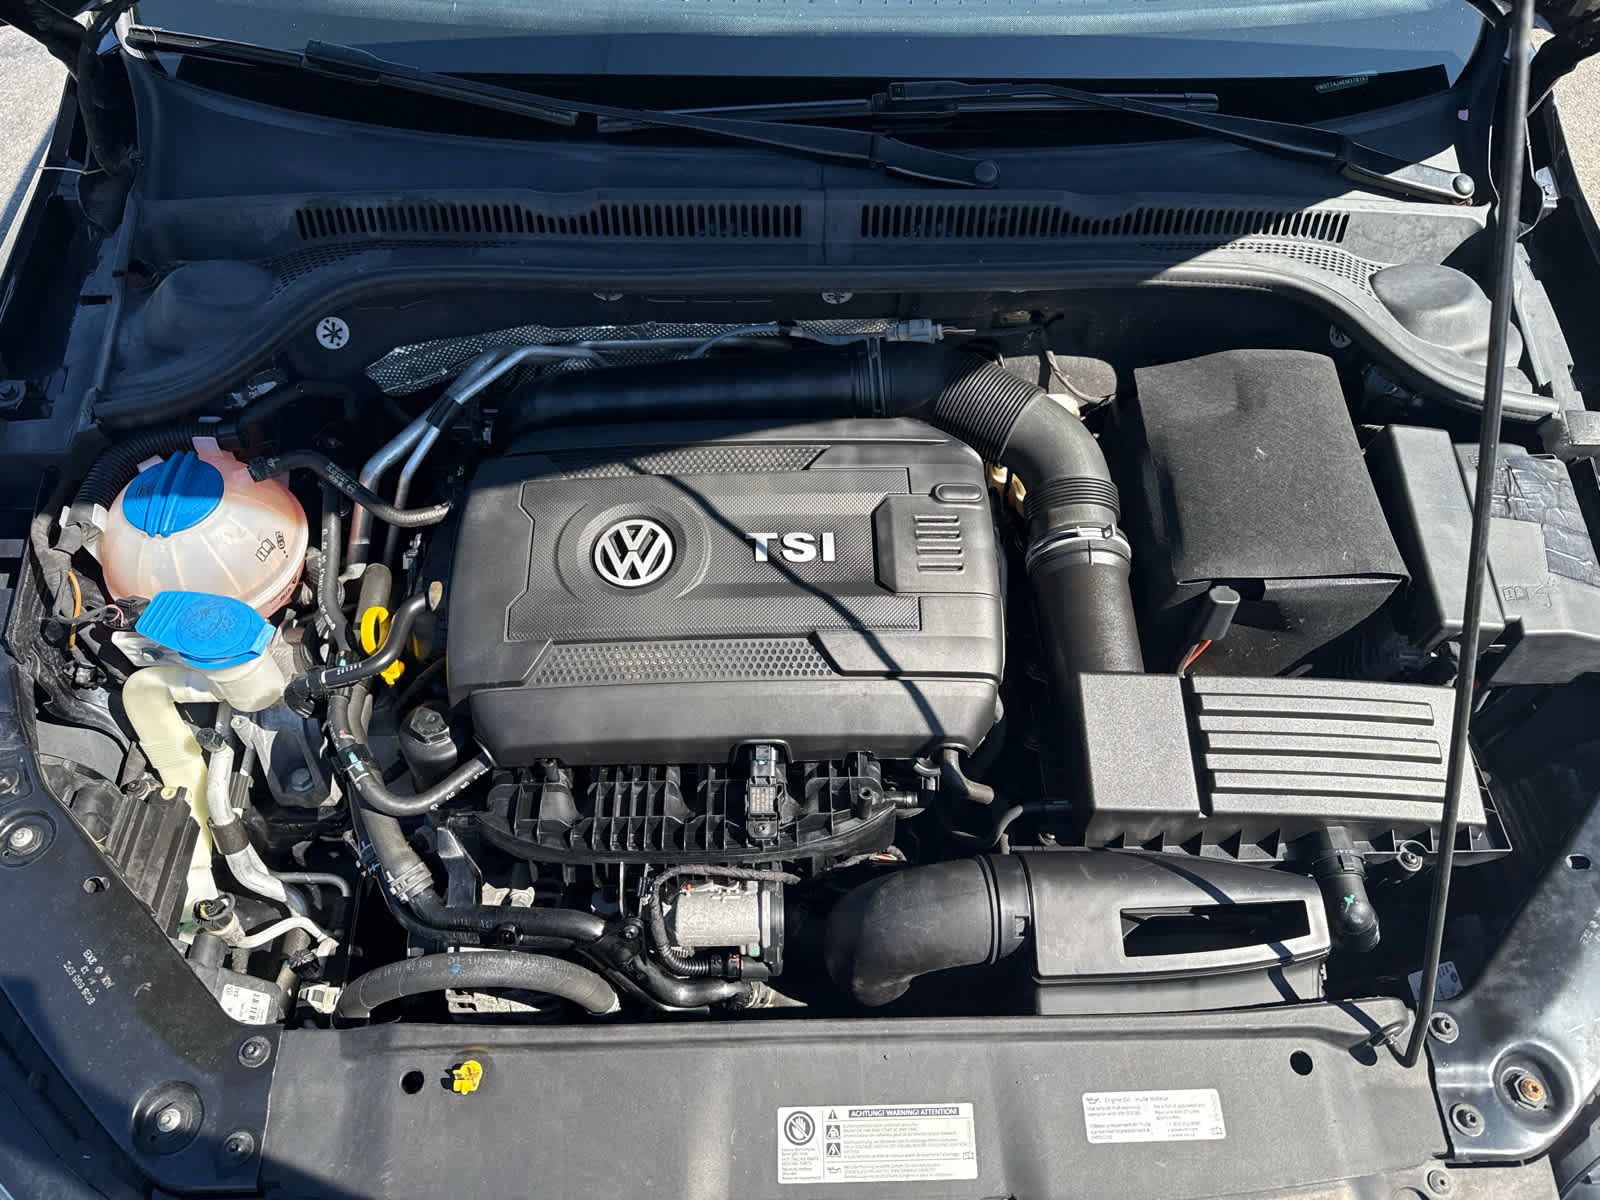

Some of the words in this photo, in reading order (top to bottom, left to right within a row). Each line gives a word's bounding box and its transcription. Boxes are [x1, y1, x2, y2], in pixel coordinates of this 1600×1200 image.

[745, 532, 836, 563] TSI
[850, 1109, 885, 1118] ACHTUNG!
[886, 1109, 919, 1117] WARNING!
[920, 1108, 957, 1116] ATTENTION!
